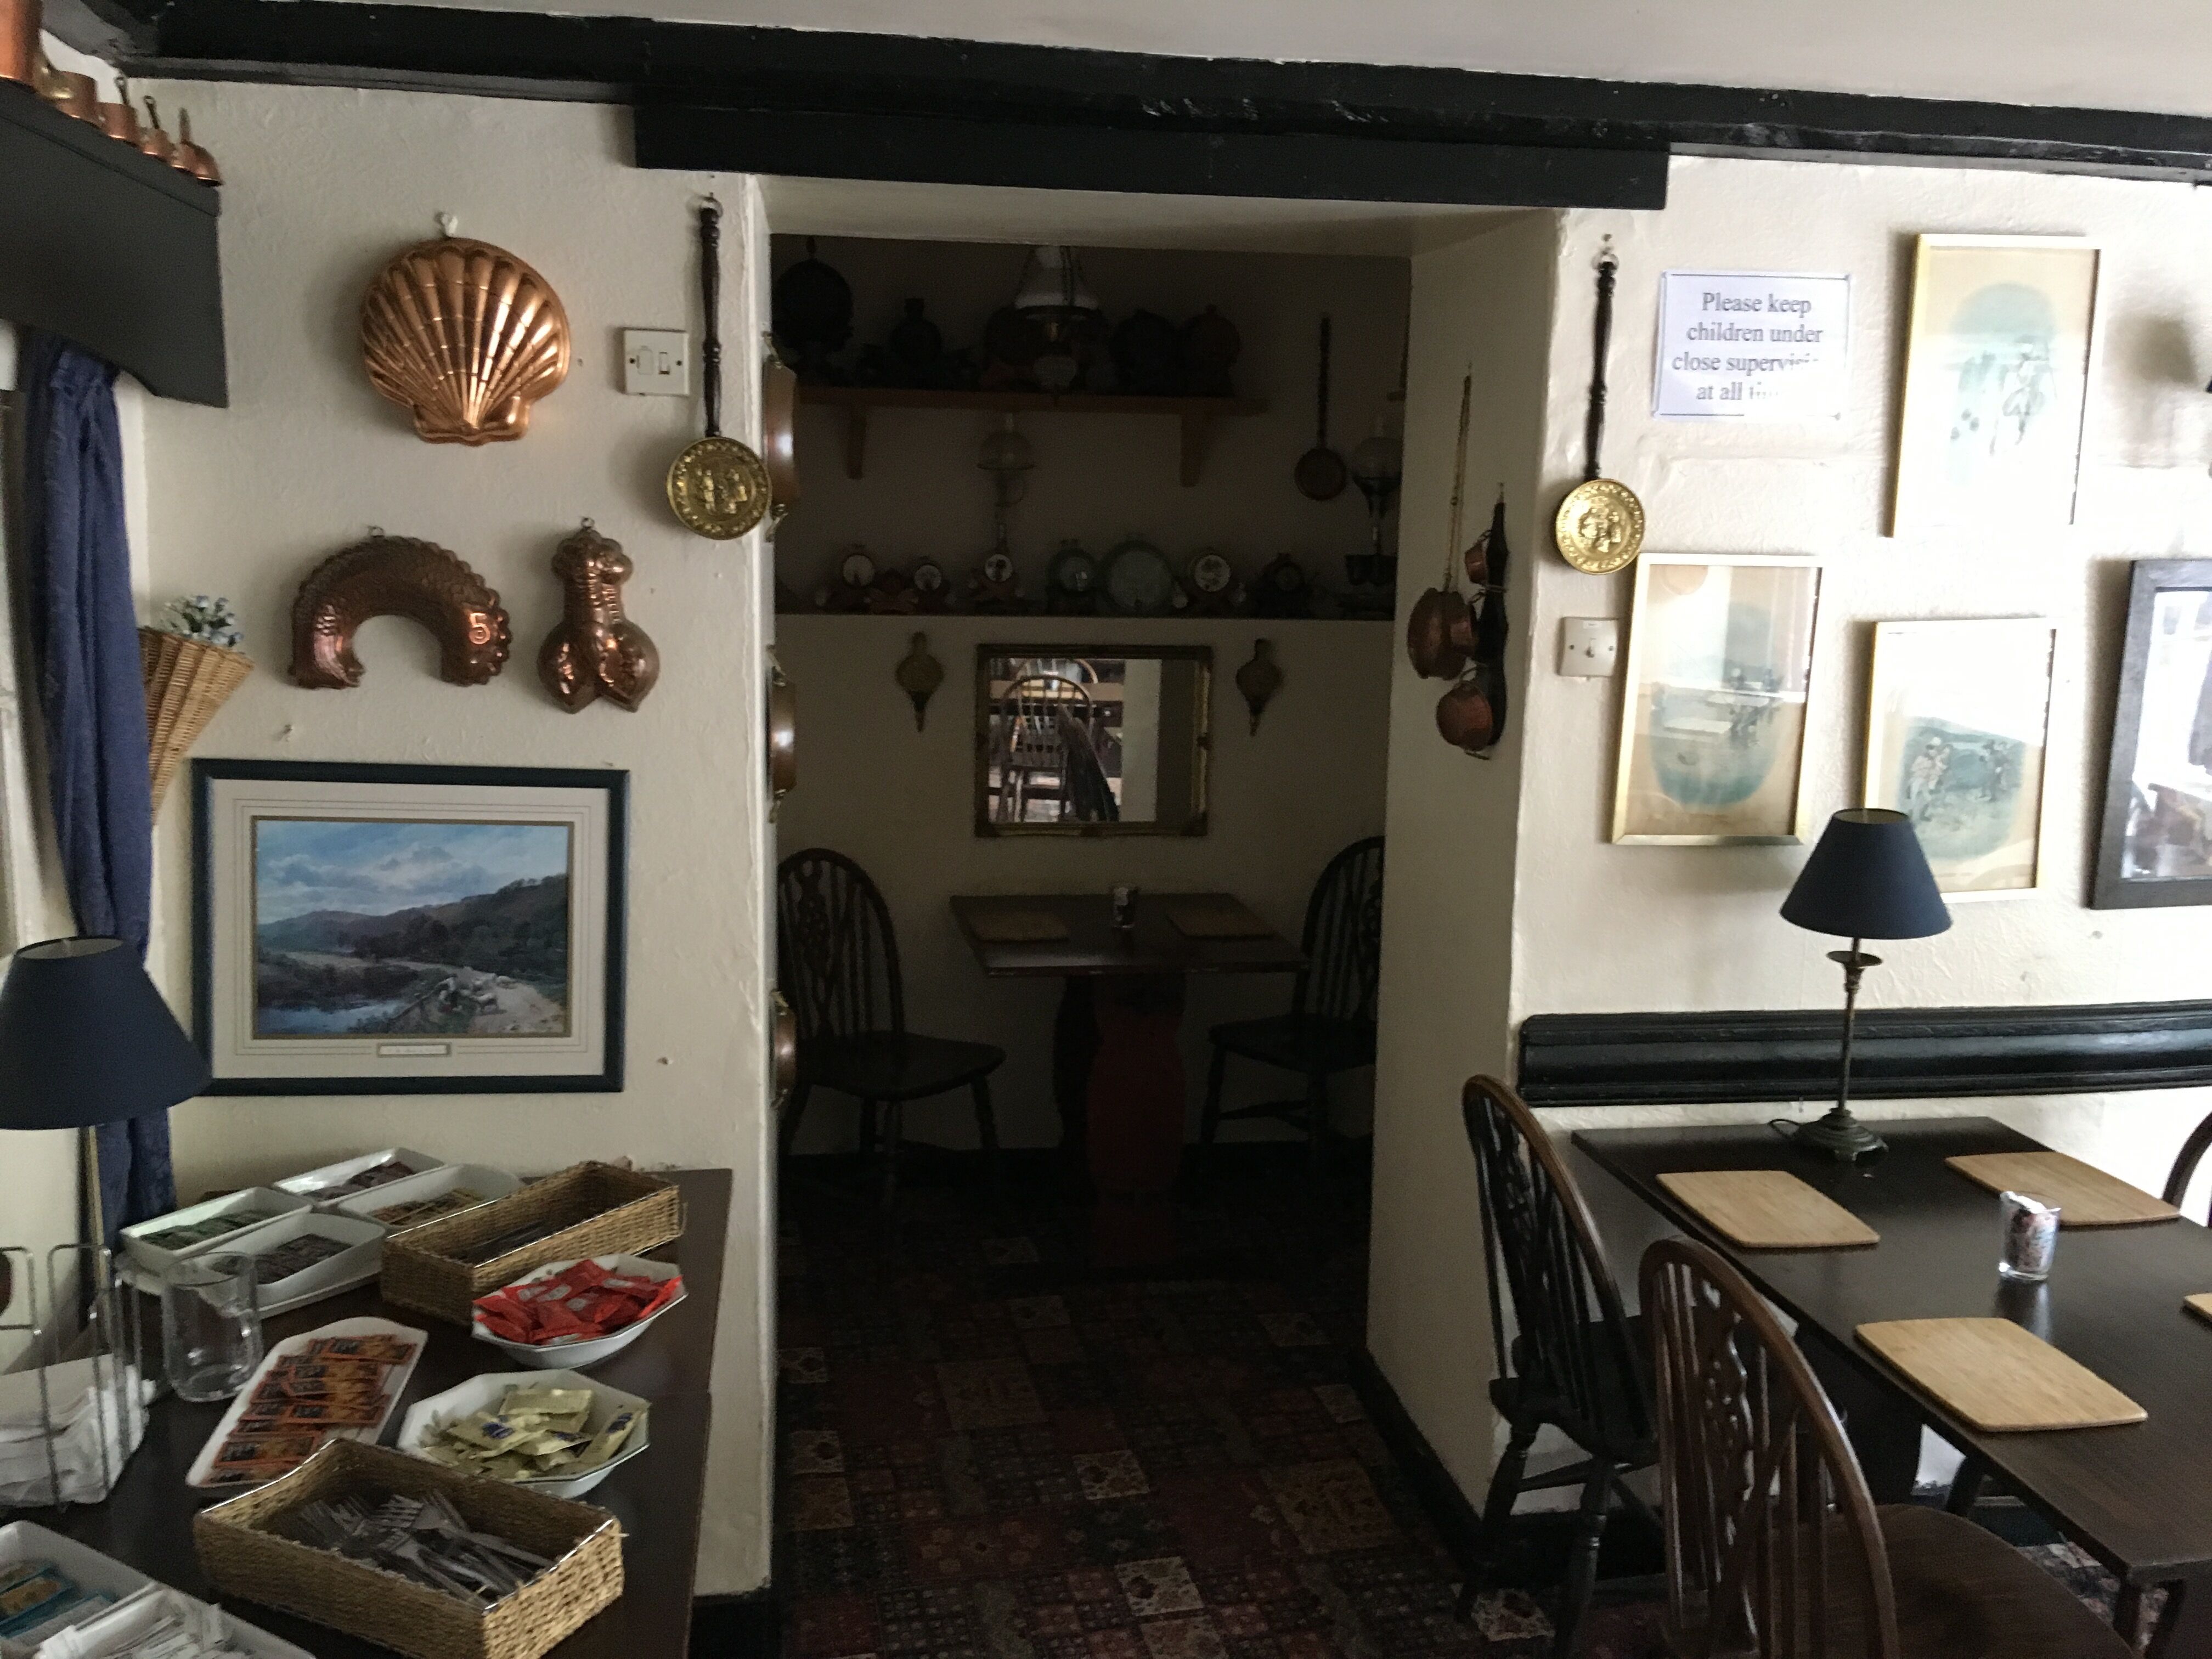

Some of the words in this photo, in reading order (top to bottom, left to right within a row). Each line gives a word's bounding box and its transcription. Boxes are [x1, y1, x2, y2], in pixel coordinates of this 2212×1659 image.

[1702, 292, 1762, 312] Please
[1768, 294, 1811, 318] keep
[1687, 322, 1763, 341] children
[1770, 324, 1824, 342] under
[1672, 352, 1720, 371] close
[1726, 353, 1818, 376] supervis
[1696, 385, 1713, 400] at
[1719, 381, 1742, 400] all
